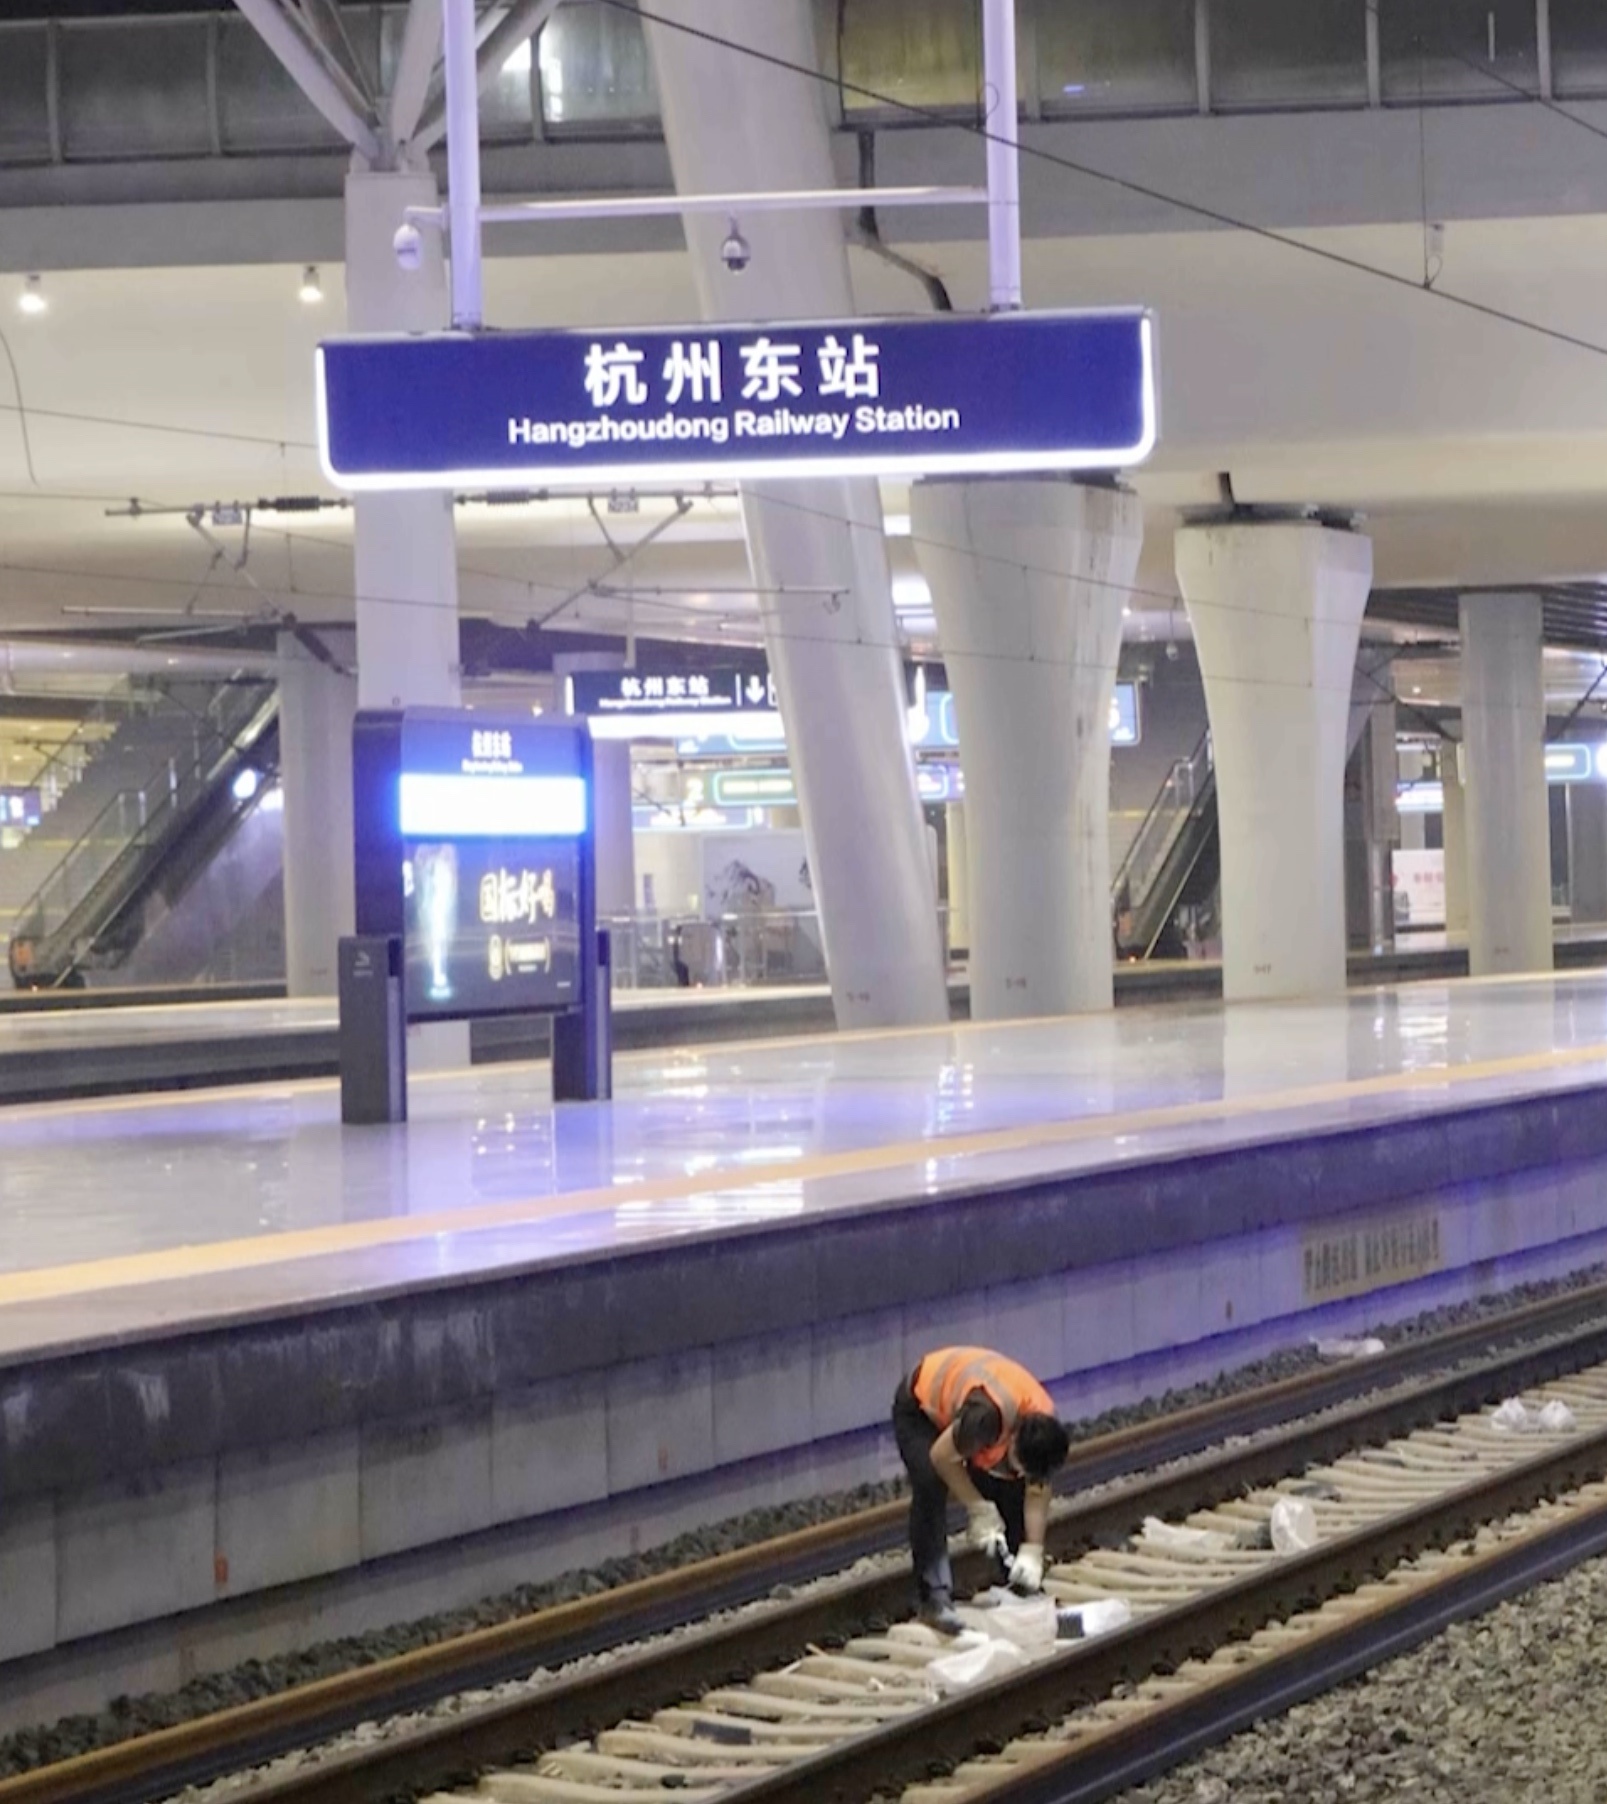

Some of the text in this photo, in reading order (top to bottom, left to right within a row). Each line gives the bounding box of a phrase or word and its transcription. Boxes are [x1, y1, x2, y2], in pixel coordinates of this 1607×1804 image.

[583, 334, 880, 407] 杭州东站
[507, 405, 960, 448] Hangzhoudong Railway Station
[620, 674, 710, 698] 杭州东站
